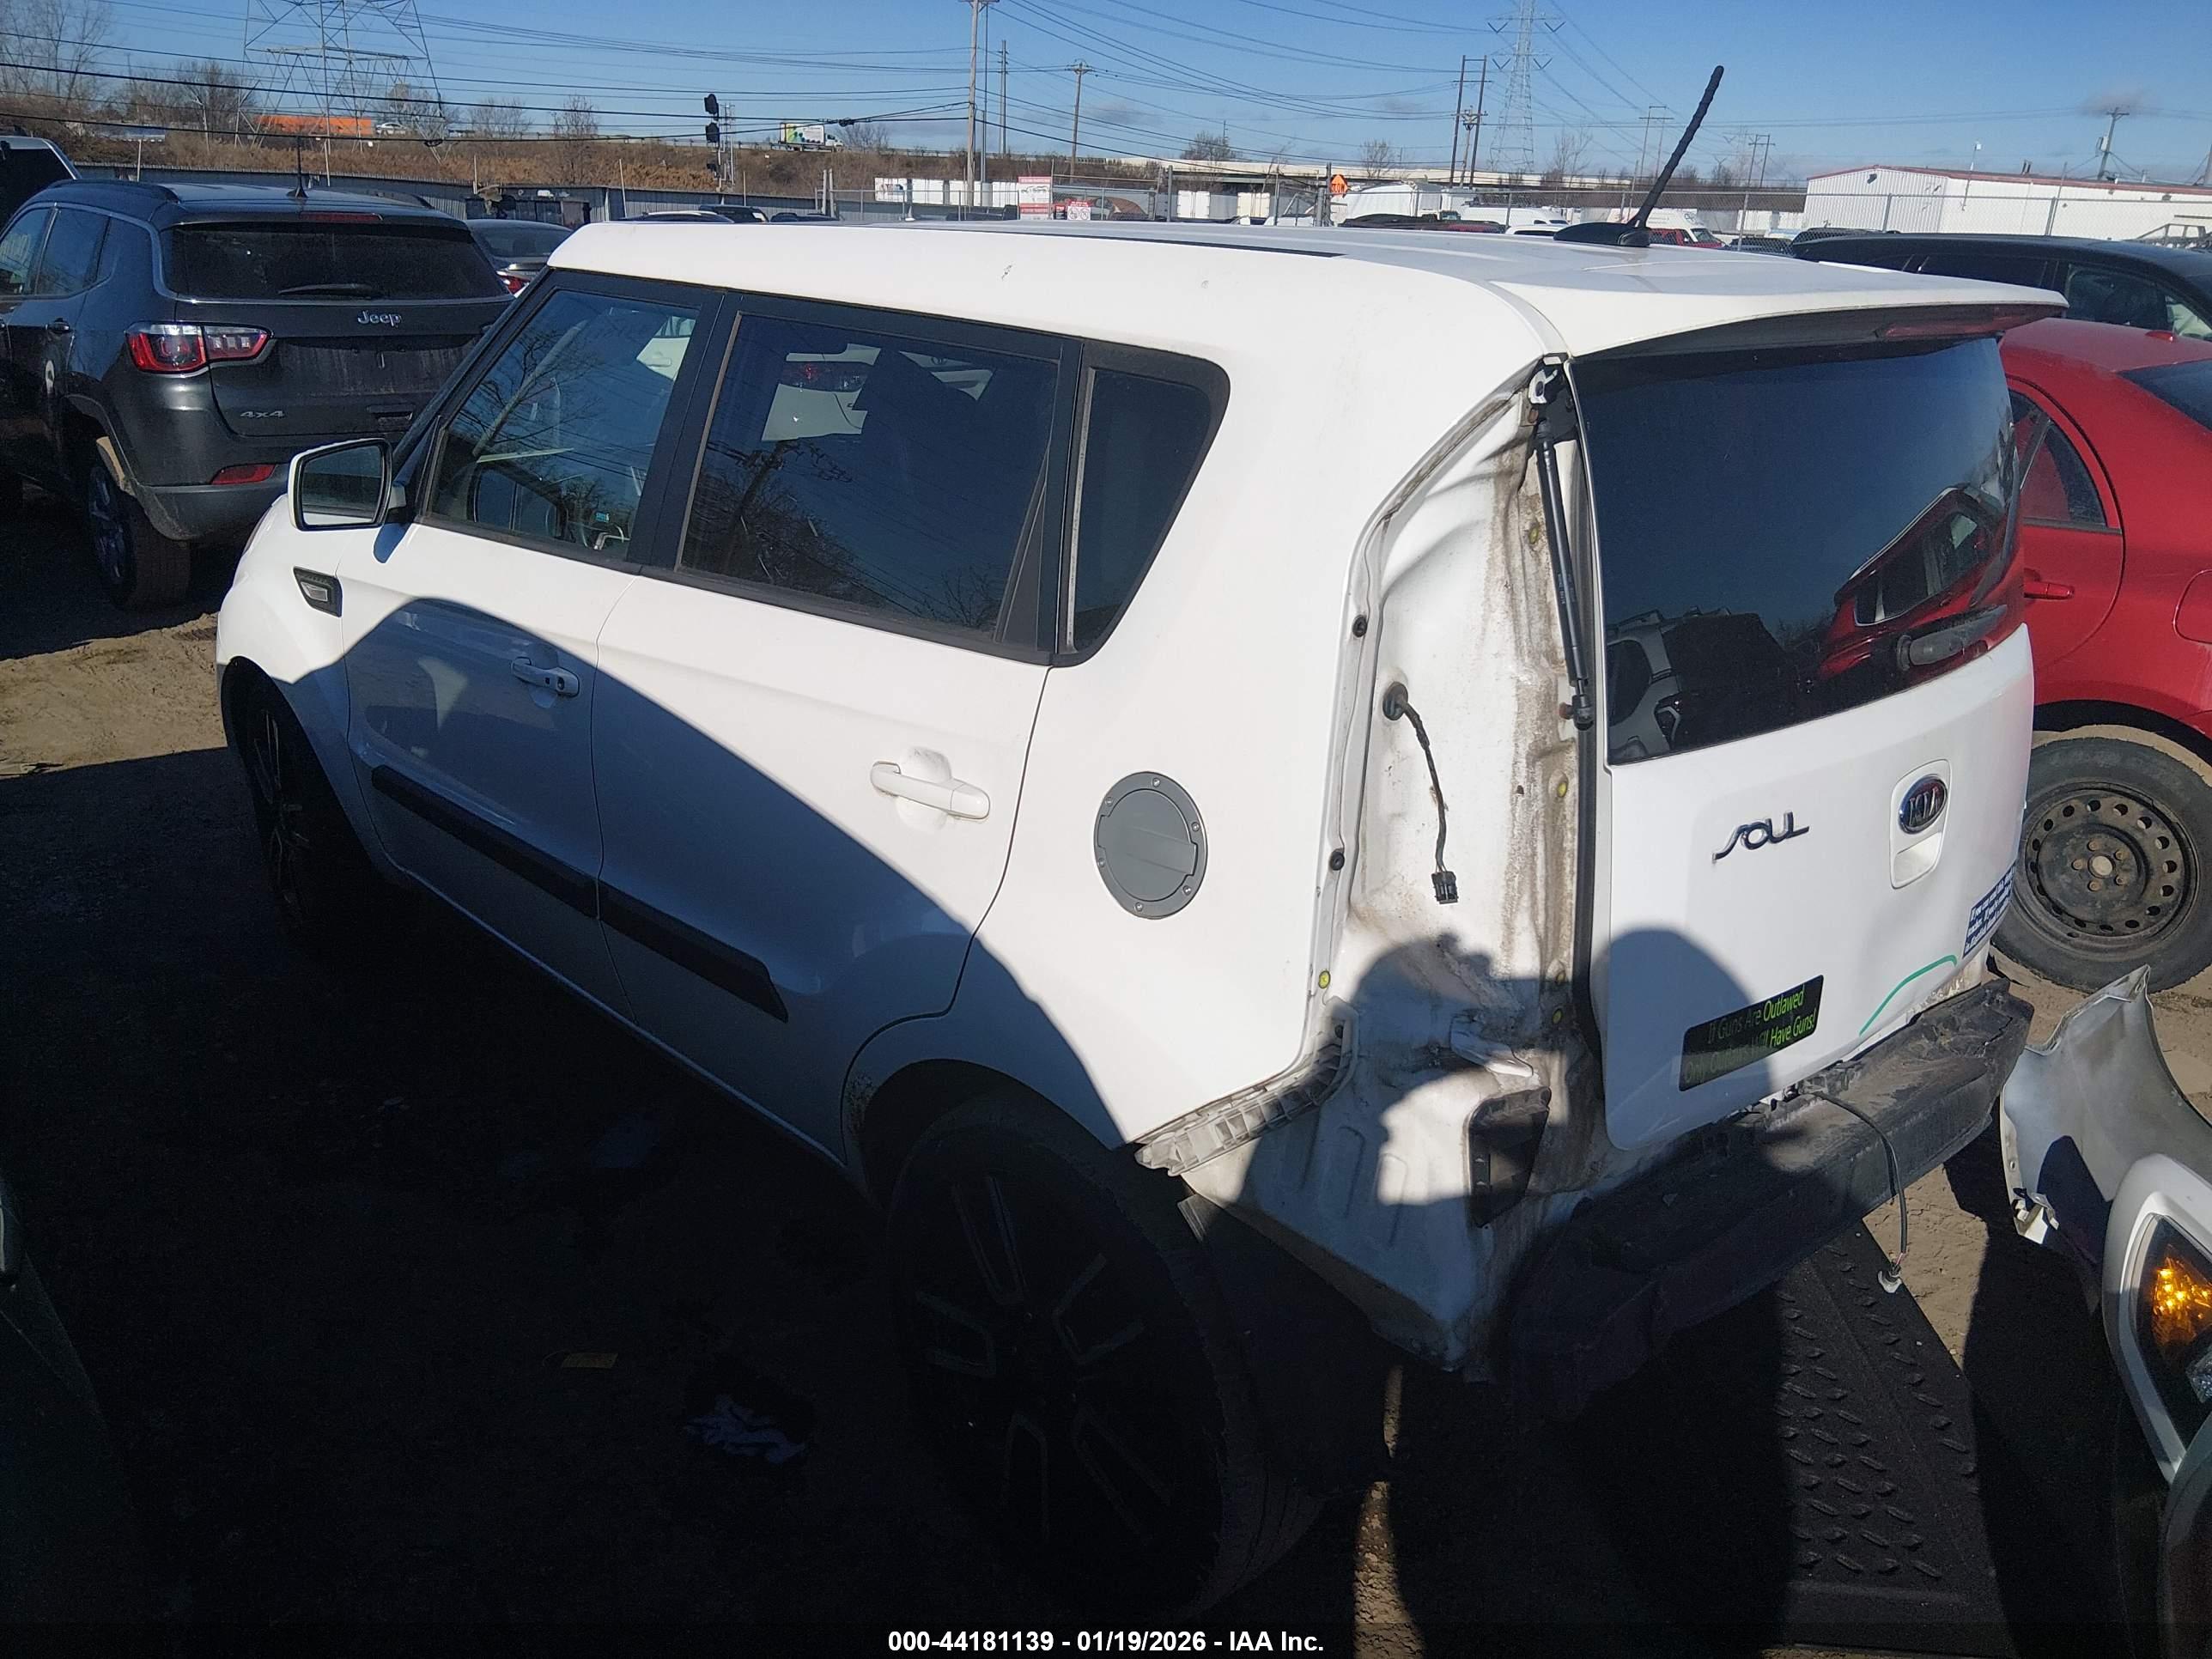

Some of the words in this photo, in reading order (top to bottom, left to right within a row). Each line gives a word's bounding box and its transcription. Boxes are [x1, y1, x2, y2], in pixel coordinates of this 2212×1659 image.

[357, 309, 402, 329] Jeep
[240, 410, 286, 420] 4x4
[1909, 786, 1941, 825] KIA
[1711, 811, 1810, 864] SOUL
[1707, 1023, 1716, 1044] If
[1717, 1015, 1742, 1040] Guns
[1744, 1007, 1762, 1028] Are
[1763, 984, 1806, 1023] Outlawed
[1769, 1024, 1792, 1048] Have
[1792, 1008, 1817, 1037] Guns!
